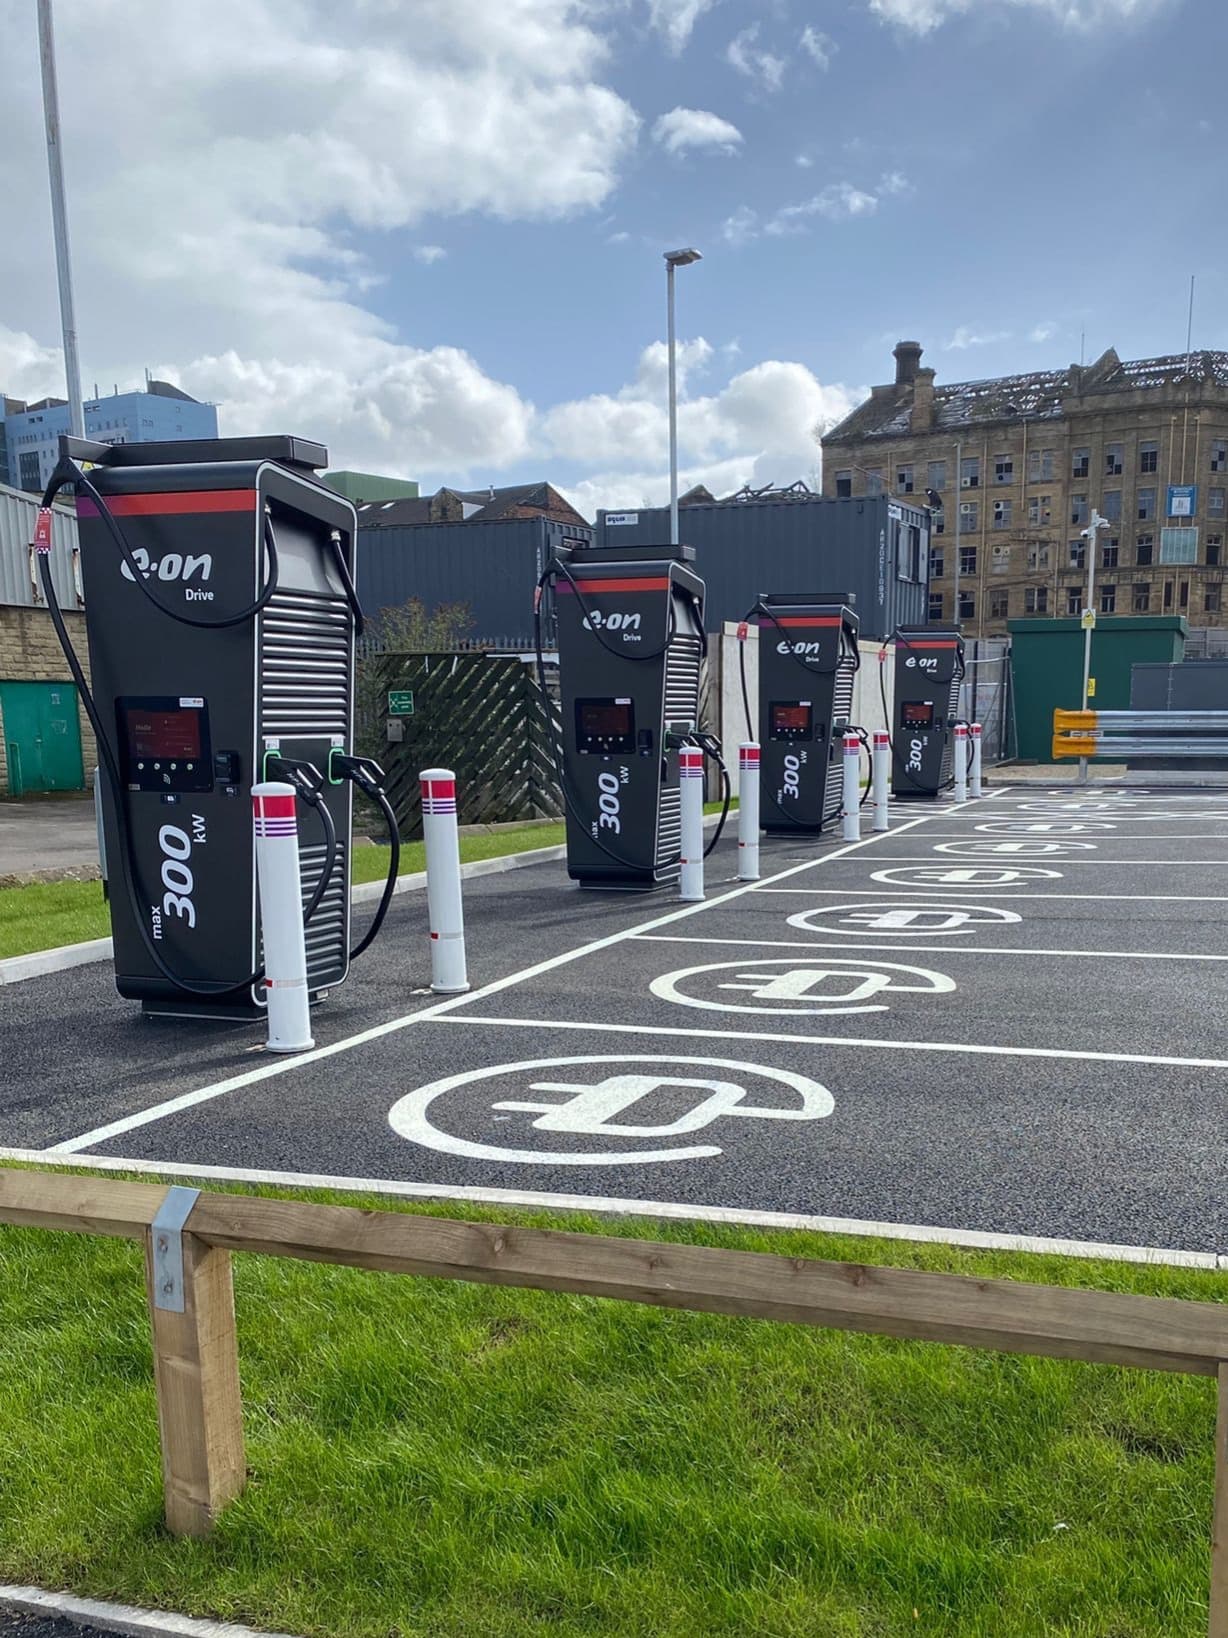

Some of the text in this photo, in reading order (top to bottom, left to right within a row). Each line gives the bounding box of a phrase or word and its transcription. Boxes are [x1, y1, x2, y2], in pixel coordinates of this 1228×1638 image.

[185, 588, 214, 601] Drive
[622, 633, 642, 642] Drive
[909, 738, 923, 772] 300
[619, 765, 630, 785] kW
[783, 754, 800, 800] 300
[598, 772, 621, 835] 300
[191, 813, 207, 844] kW
[158, 823, 197, 929] 300
[151, 906, 162, 940] max
